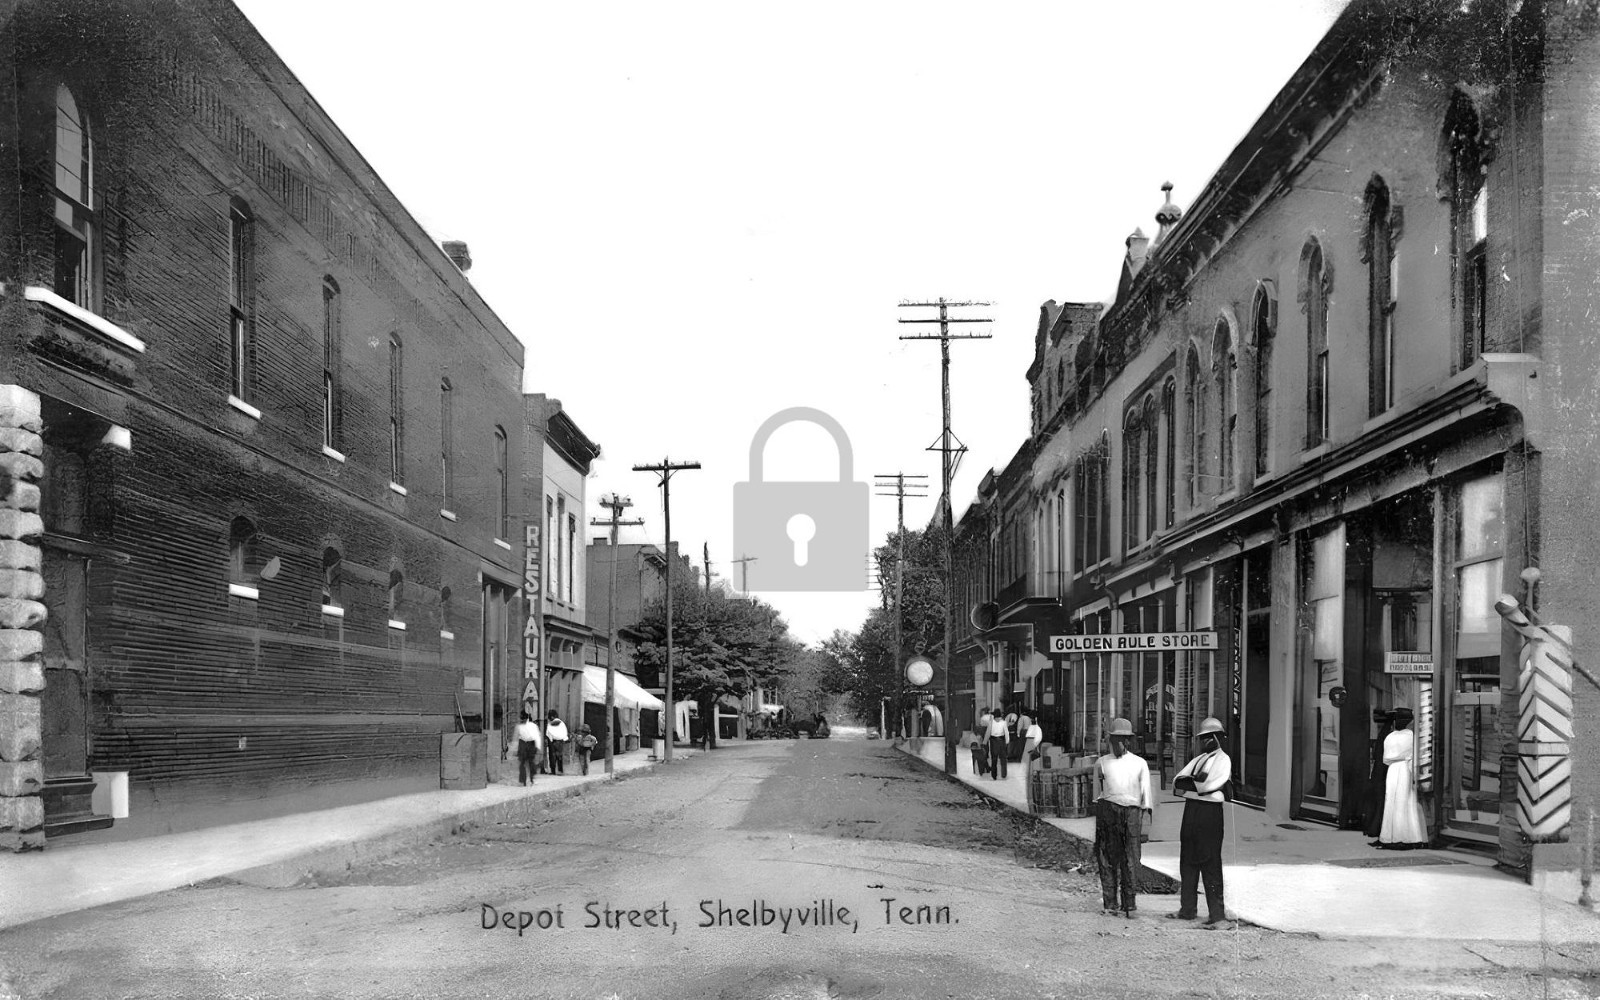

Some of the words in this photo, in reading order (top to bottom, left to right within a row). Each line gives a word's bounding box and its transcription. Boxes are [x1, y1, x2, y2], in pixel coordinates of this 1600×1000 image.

[523, 525, 540, 721] RESTAURAN
[1055, 637, 1113, 650] GOLDEN
[1117, 636, 1156, 649] RULE
[1162, 634, 1210, 647] STORE
